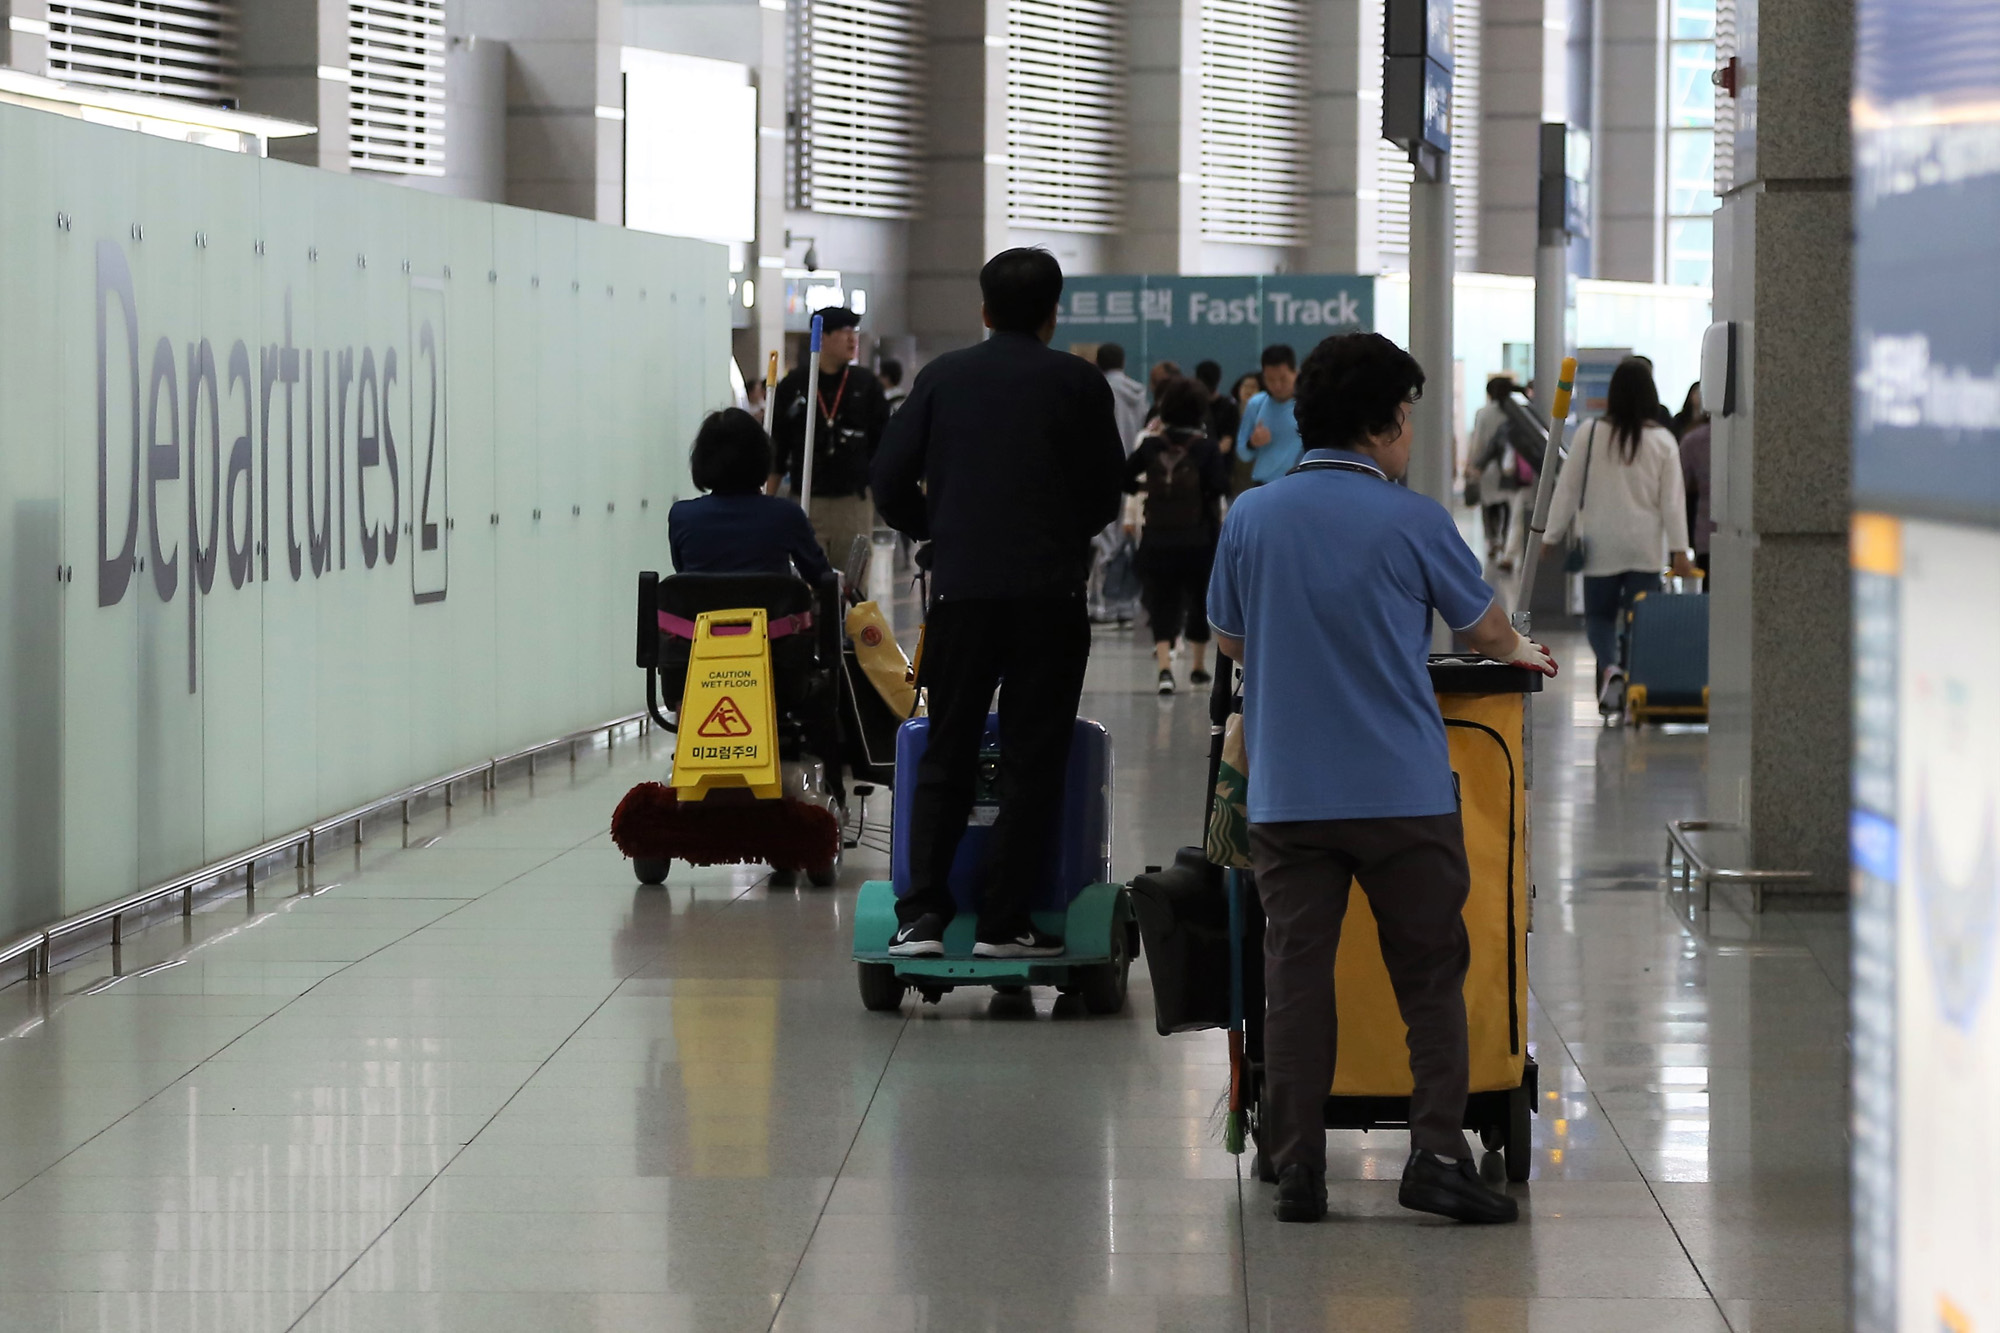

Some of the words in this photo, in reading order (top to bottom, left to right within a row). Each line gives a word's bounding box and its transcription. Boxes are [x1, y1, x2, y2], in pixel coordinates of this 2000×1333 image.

[1189, 292, 1261, 325] Fast
[1268, 290, 1360, 325] Track
[97, 239, 399, 694] Departures
[421, 319, 438, 551] 2
[709, 670, 751, 679] CAUTION
[724, 680, 757, 688] FLOOR
[692, 745, 757, 760] 미끄럼주의
